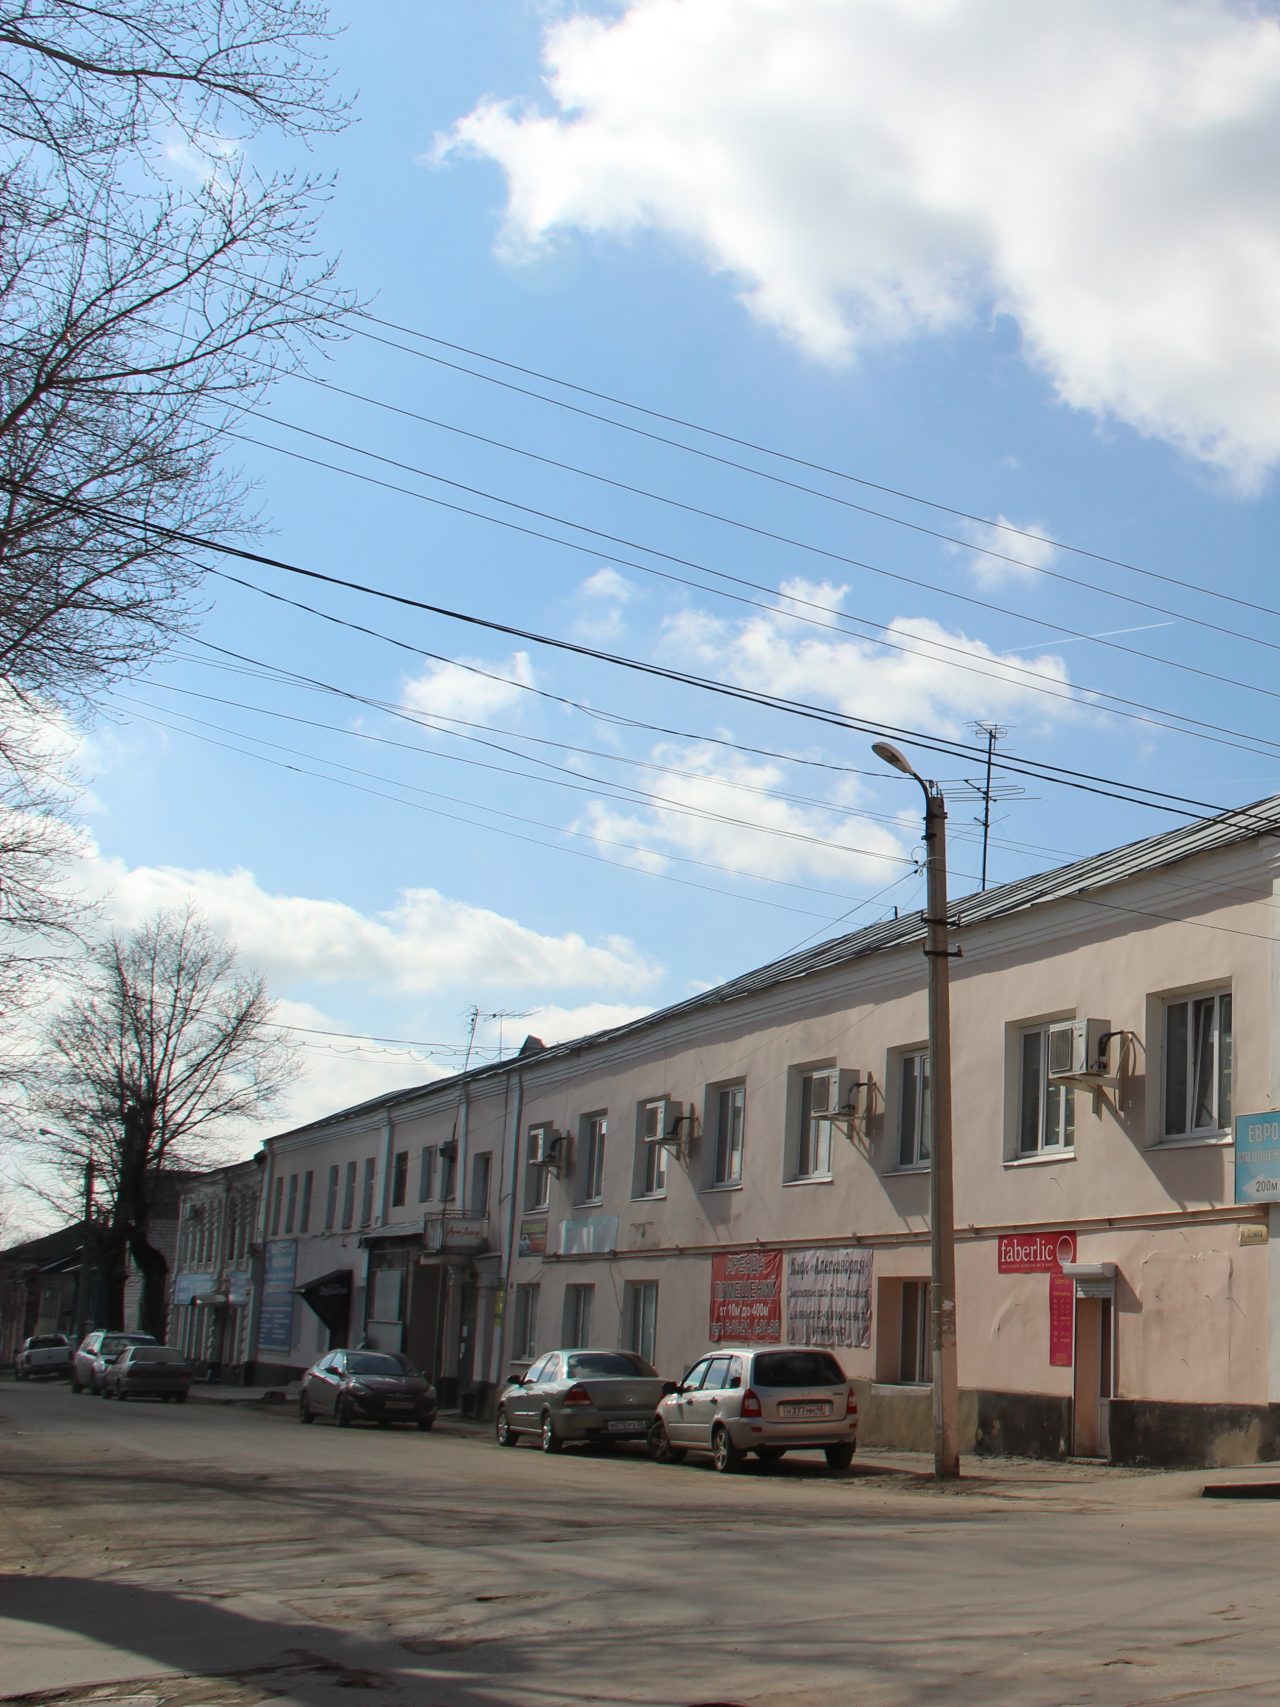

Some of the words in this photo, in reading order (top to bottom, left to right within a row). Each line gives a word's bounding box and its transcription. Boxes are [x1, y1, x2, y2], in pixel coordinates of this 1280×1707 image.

[1248, 1122, 1279, 1144] ЕВРО
[1001, 1238, 1054, 1262] faberlic
[726, 1254, 766, 1274] АРЕНДА
[714, 1275, 777, 1300] ПОМЕЩЕНИЙ
[719, 1306, 727, 1317] от
[741, 1306, 751, 1319] до
